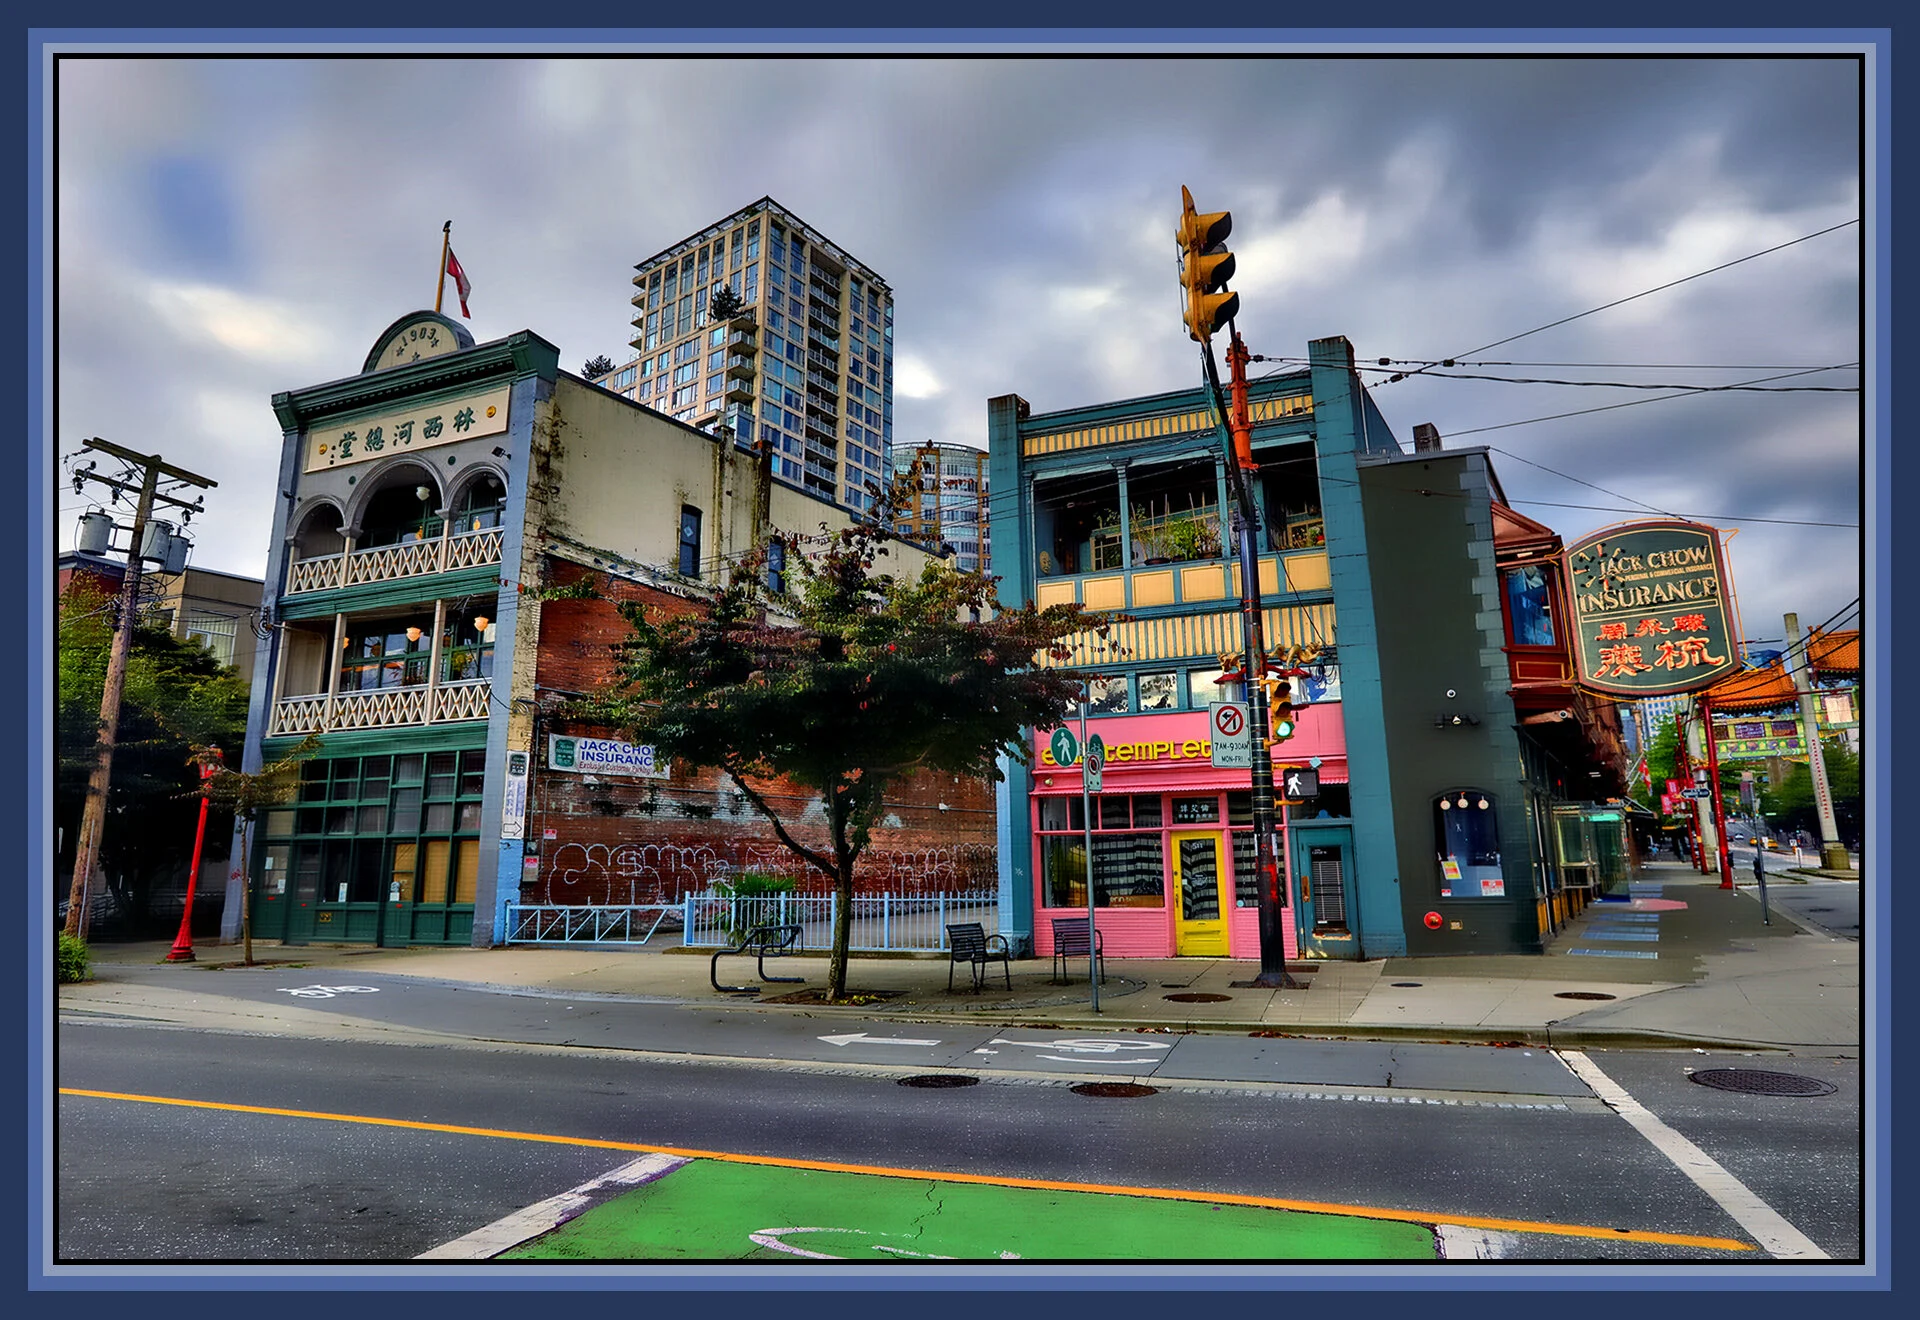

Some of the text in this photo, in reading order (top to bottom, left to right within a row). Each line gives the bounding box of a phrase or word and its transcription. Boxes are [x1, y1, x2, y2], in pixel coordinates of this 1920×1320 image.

[402, 327, 437, 347] 1903
[1600, 545, 1708, 580] JACK CHOW
[1579, 577, 1719, 612] INSURANCE
[580, 741, 655, 756] JACK CHO
[581, 751, 653, 767] INSURANC
